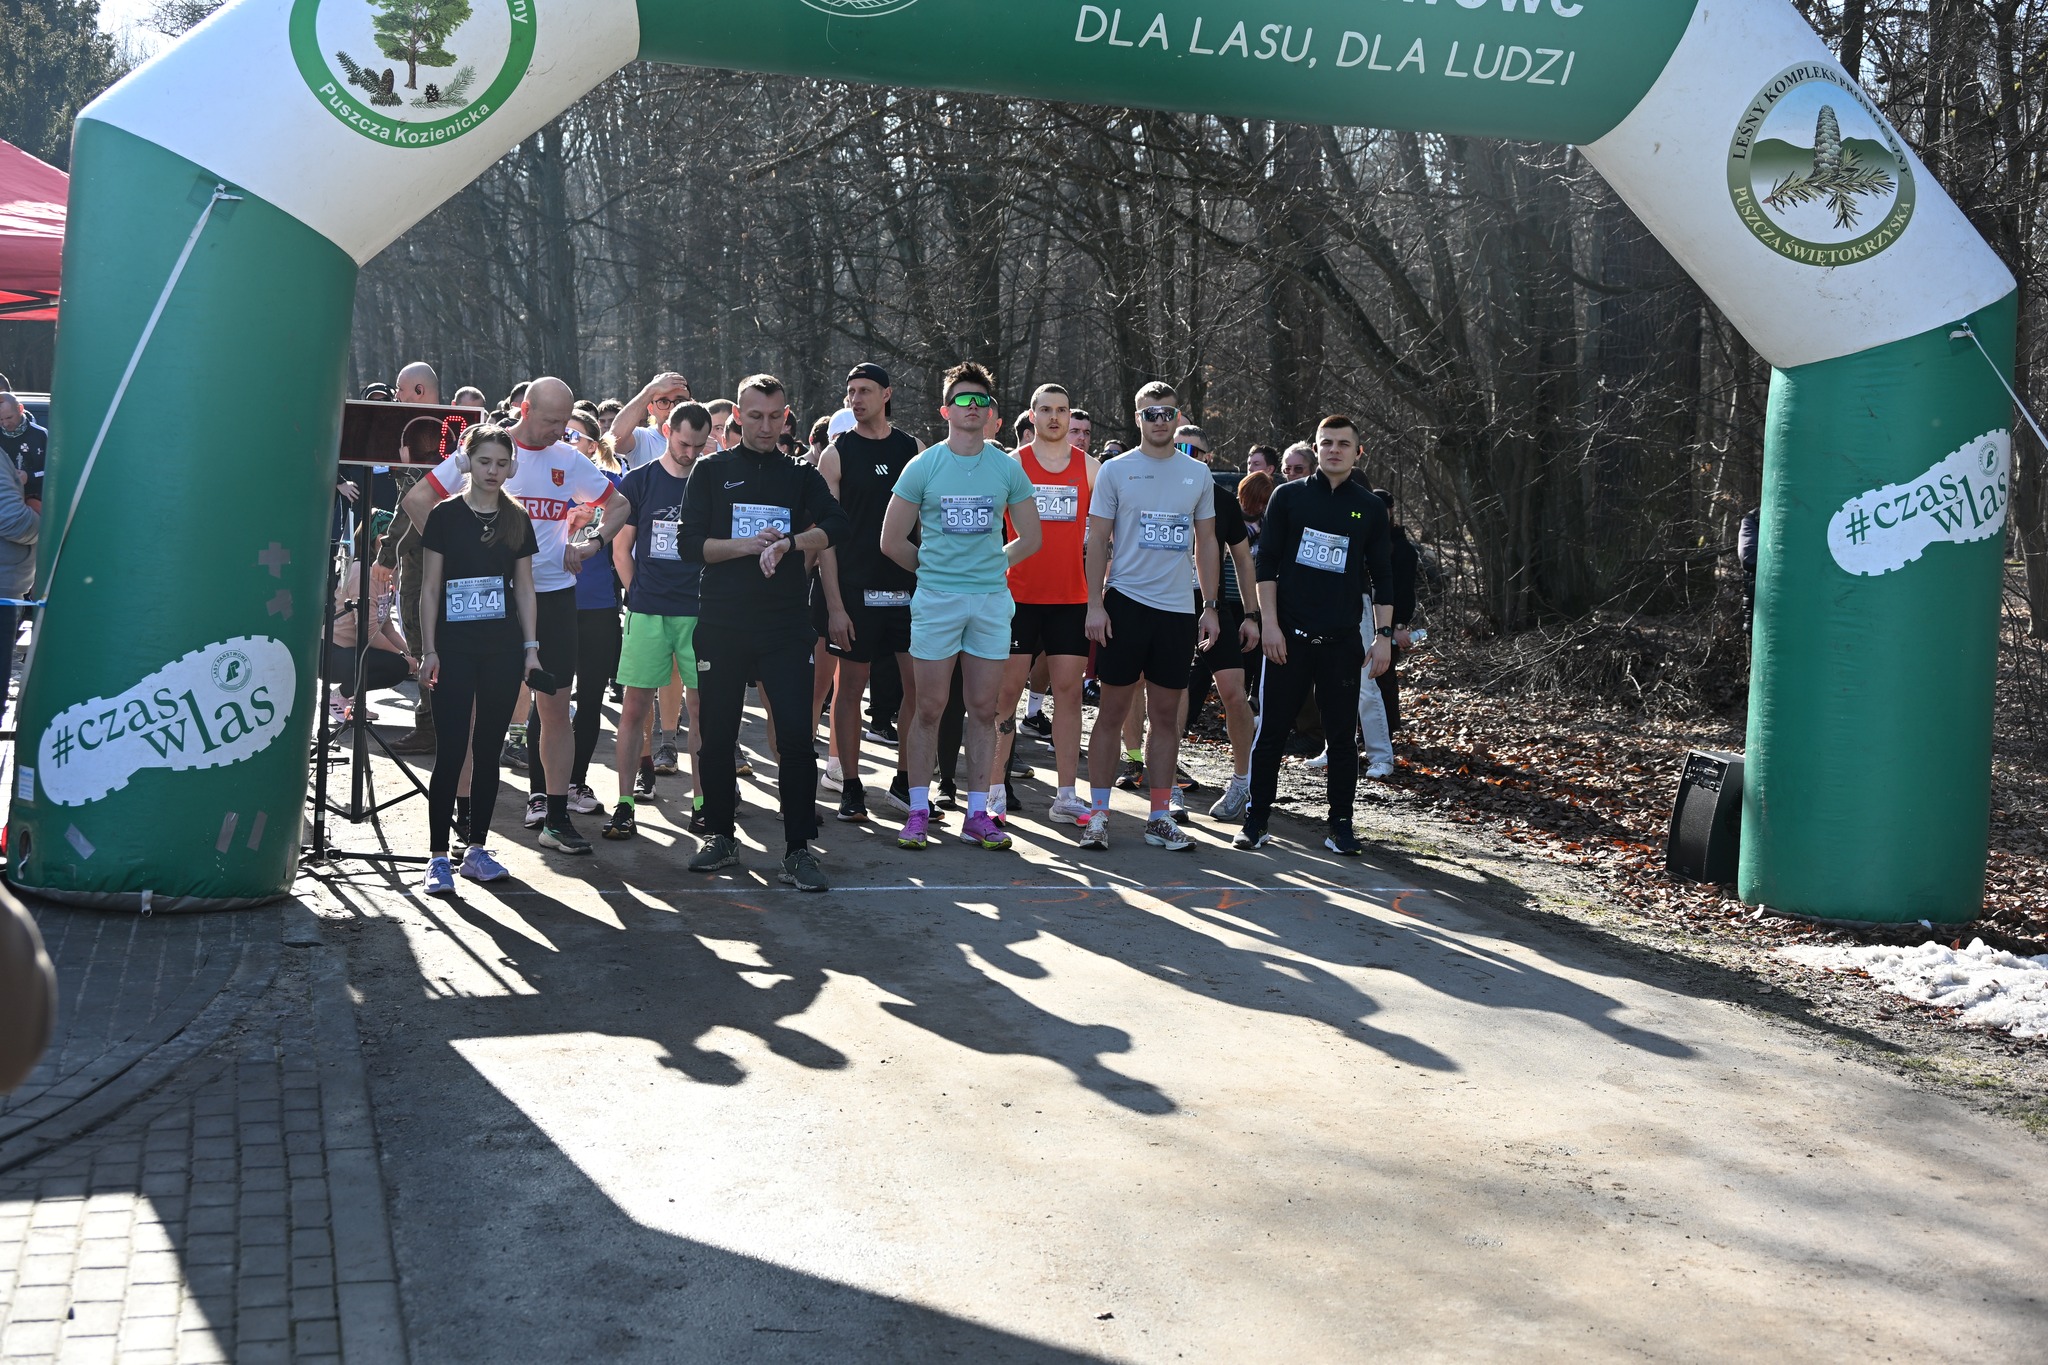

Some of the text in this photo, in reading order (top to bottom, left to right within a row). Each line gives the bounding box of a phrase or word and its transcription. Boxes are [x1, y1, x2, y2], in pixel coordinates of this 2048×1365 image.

[1075, 5, 1575, 86] DLA LASU, DLA LUDZI
[319, 82, 490, 144] Puszcza Kozienicka
[1733, 66, 1910, 178] LEŚNY KOMPLEKS PROMOCYJNY
[1733, 186, 1911, 266] PUSZCZA ŚWIĘTOKRZYSKA
[518, 499, 564, 519] RKA
[946, 507, 989, 526] 535
[1036, 496, 1071, 515] 541
[1845, 473, 1958, 546] #czas
[738, 517, 785, 537] 532
[1144, 523, 1184, 544] 536
[656, 532, 679, 551] 54
[1302, 540, 1343, 565] 580
[451, 590, 501, 613] 544
[52, 687, 179, 769] #czas
